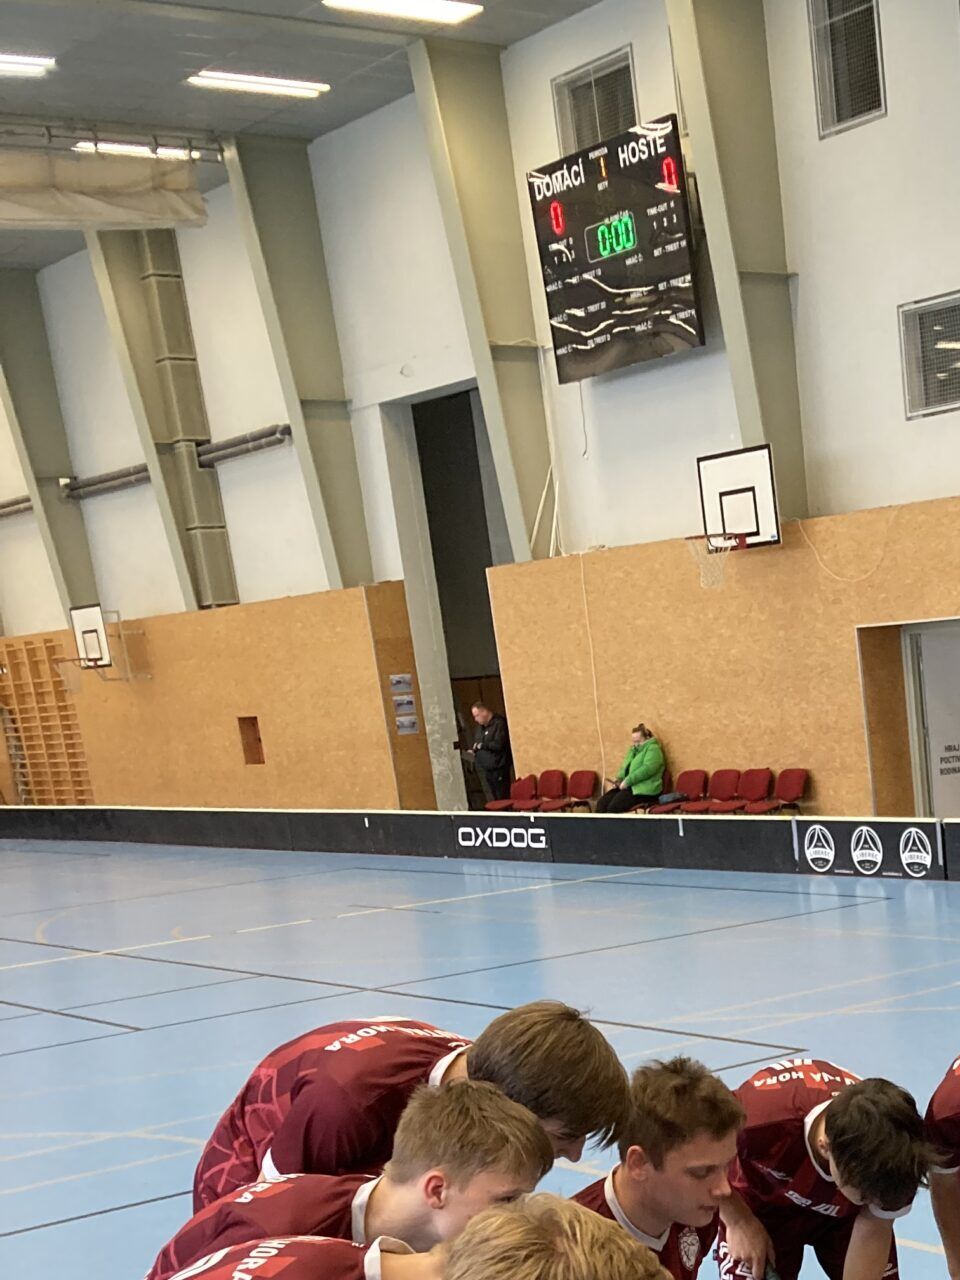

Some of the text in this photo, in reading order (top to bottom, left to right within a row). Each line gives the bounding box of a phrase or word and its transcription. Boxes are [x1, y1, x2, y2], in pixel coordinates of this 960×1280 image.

[533, 157, 585, 201] DOMÁCÍ
[550, 201, 565, 235] 0
[597, 216, 634, 257] 0:00
[458, 827, 546, 849] OXDOG
